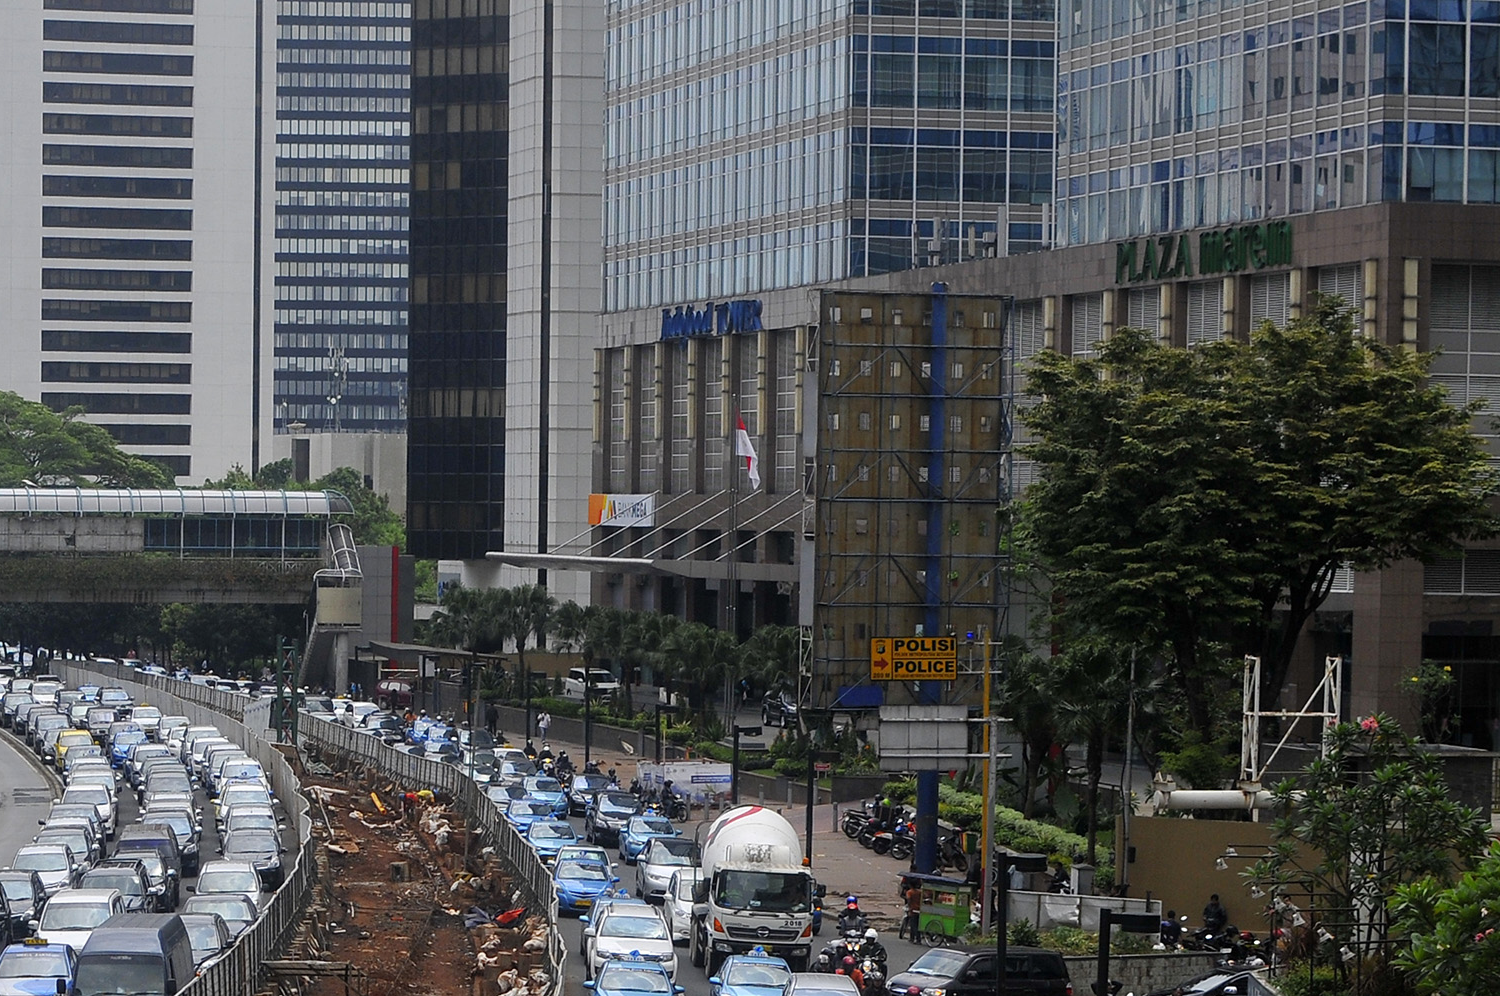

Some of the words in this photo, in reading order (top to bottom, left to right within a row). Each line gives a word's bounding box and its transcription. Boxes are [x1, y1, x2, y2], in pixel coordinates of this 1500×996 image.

[1115, 235, 1192, 285] PLAZA
[894, 640, 955, 652] POLISI
[894, 661, 955, 673] POLICE
